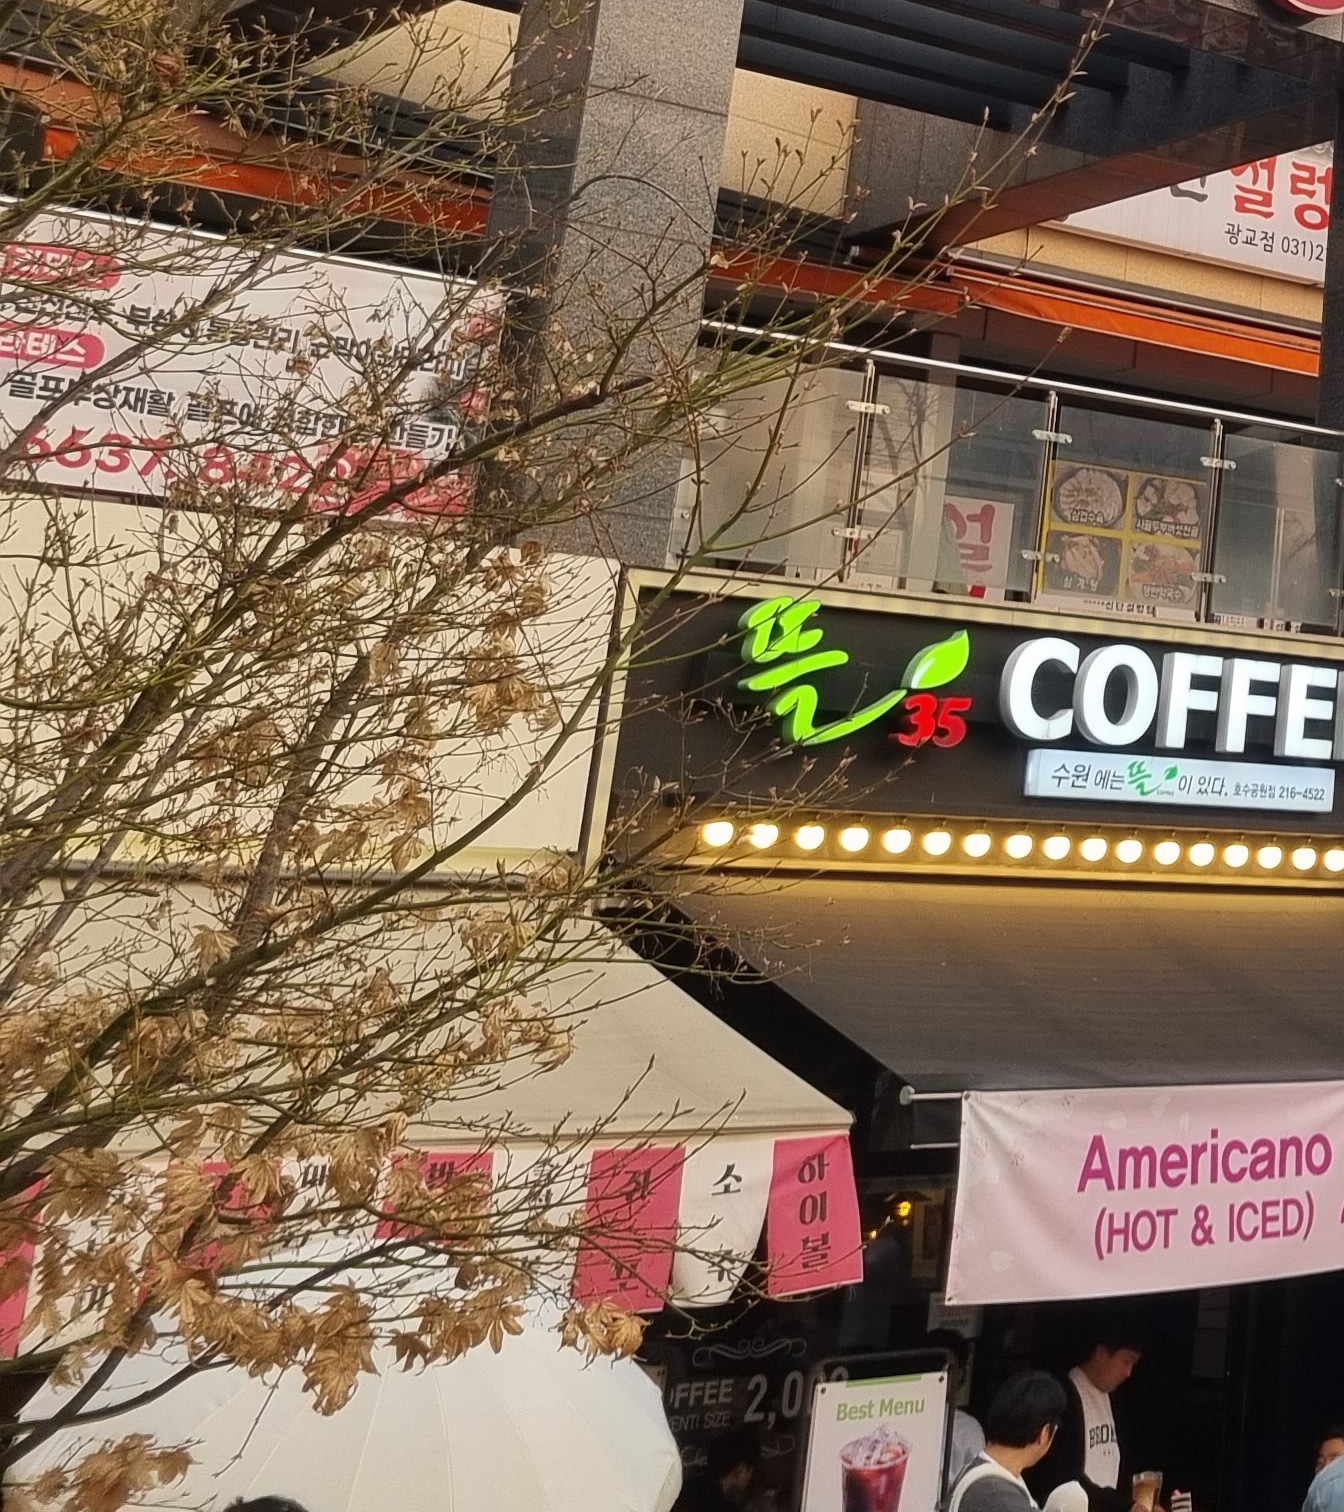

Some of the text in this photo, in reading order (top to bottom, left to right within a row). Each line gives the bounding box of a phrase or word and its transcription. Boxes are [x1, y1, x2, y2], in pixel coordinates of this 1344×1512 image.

[1224, 223, 1274, 253] 광교점
[892, 694, 973, 747] 35
[1052, 763, 1090, 789] 수원
[1233, 783, 1276, 799] 호수공원점
[1279, 784, 1325, 801] 216-4522
[1077, 1129, 1333, 1193] Americano
[797, 1153, 832, 1269] 하이볼
[1094, 1191, 1316, 1260] (HOT & ICED)
[667, 1365, 850, 1431] FFEE 2,0
[704, 1411, 731, 1430] SIZE
[836, 1395, 926, 1422] Best Menu
